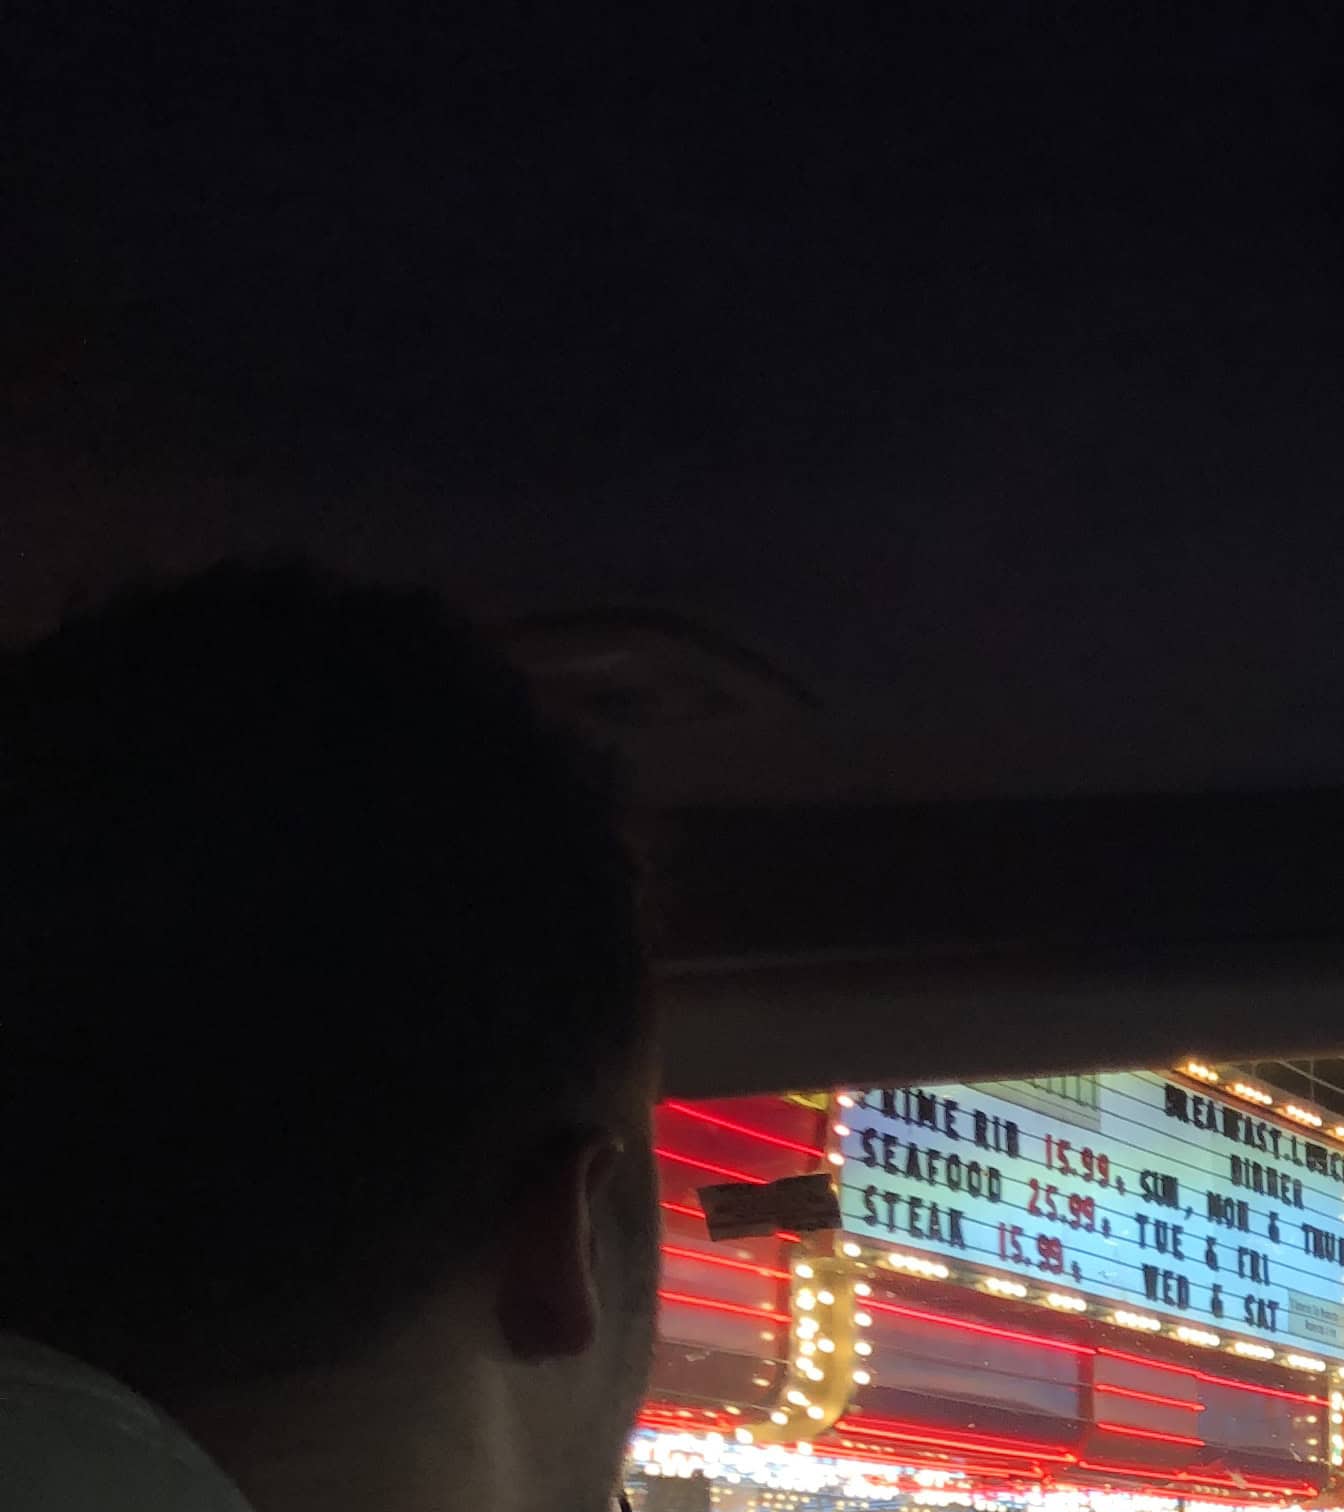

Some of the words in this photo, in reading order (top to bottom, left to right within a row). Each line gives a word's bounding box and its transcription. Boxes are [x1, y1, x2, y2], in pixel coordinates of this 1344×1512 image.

[860, 1128, 1001, 1203] SEAFOOD
[1136, 1213, 1184, 1261] TUE
[1238, 1246, 1270, 1286] FRI
[866, 1089, 959, 1140] RIME
[975, 1109, 1018, 1158] RIB
[1207, 1191, 1248, 1232] MON
[863, 1185, 966, 1249] STEAK
[1142, 1263, 1190, 1310] WED
[1244, 1295, 1279, 1333] SAT
